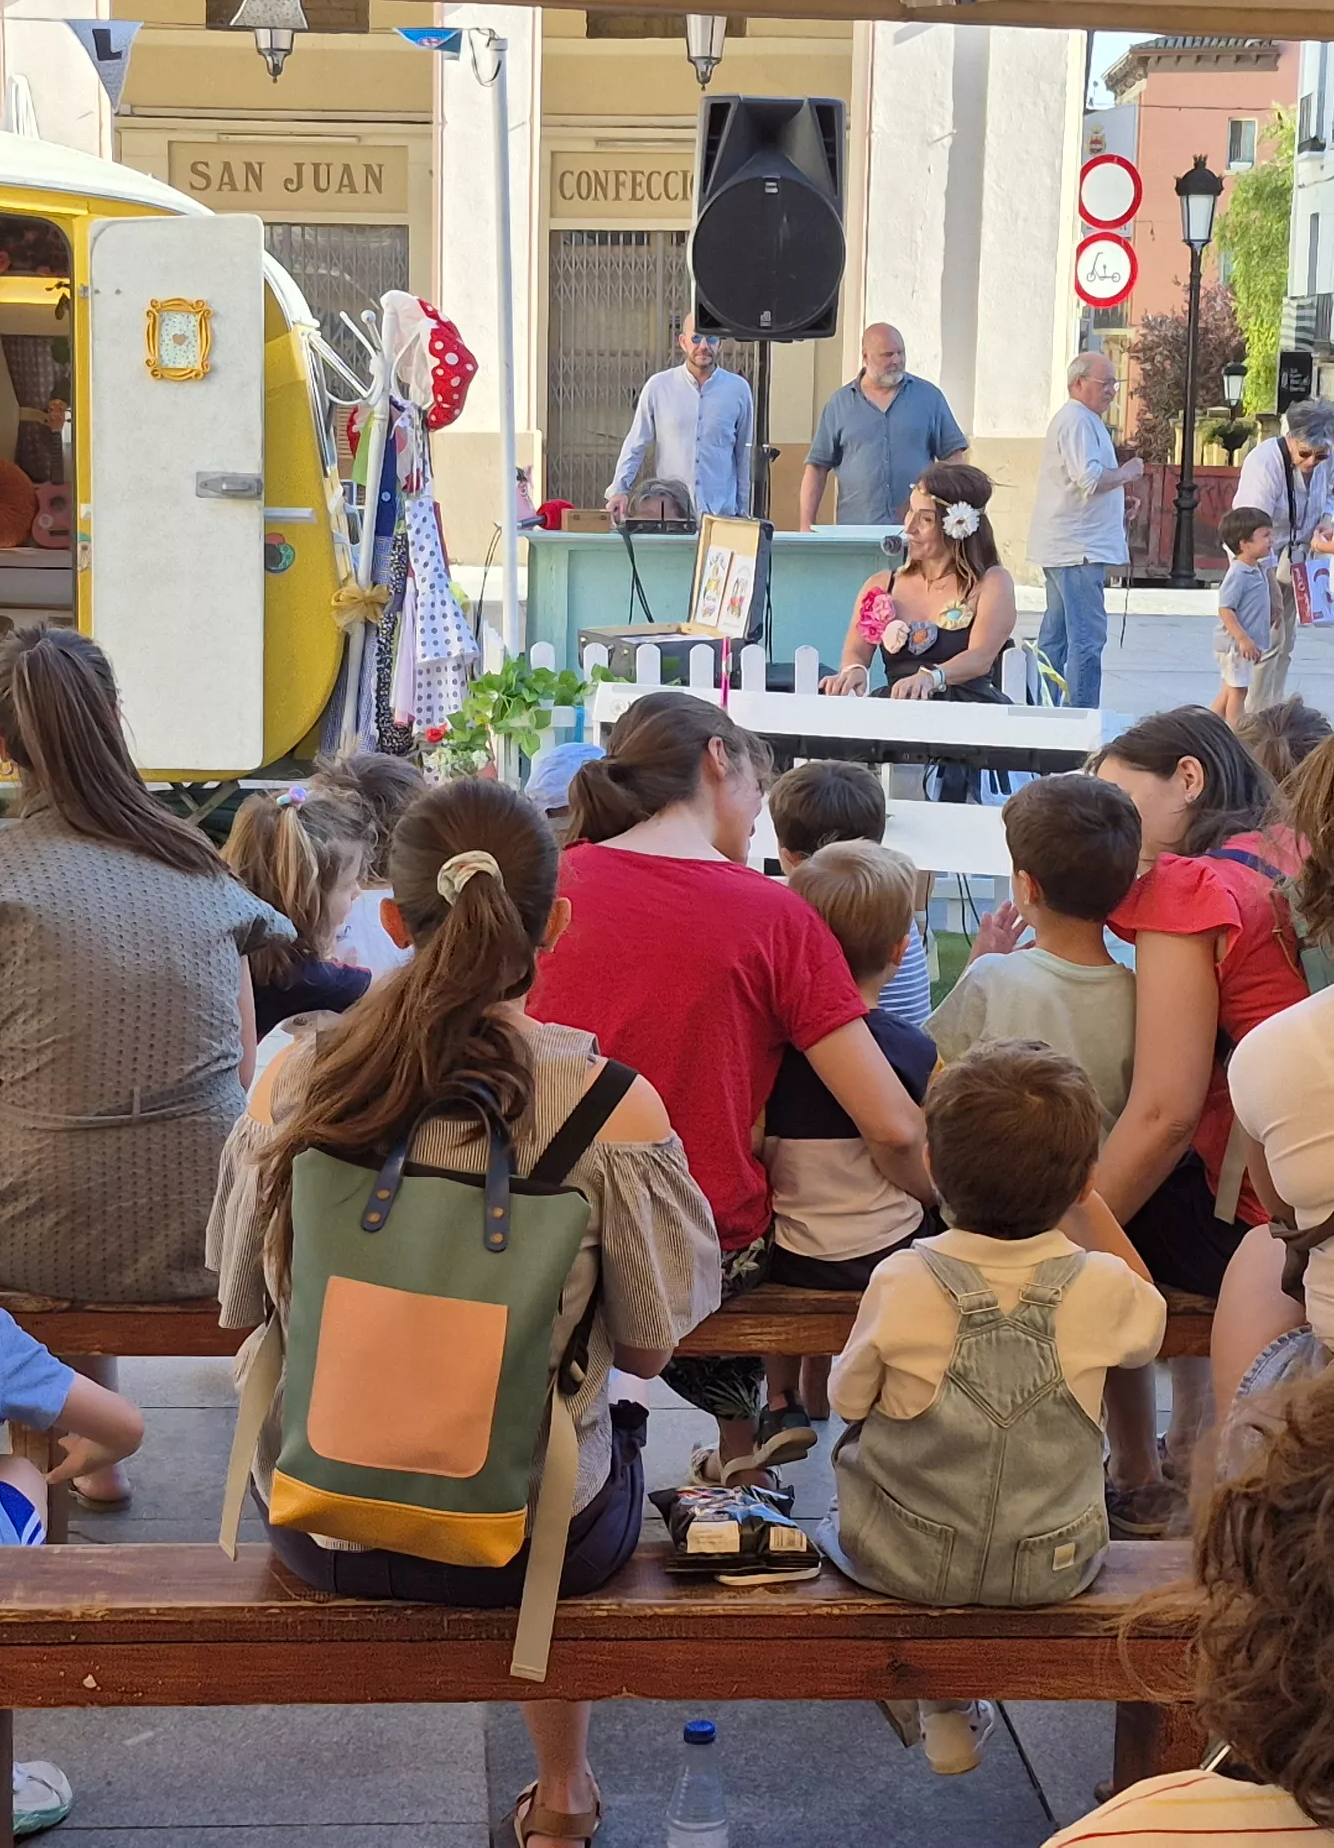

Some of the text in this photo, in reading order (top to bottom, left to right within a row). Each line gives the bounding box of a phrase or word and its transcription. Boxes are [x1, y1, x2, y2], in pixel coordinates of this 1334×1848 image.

[91, 28, 122, 61] L
[189, 160, 385, 195] SAN JUAN
